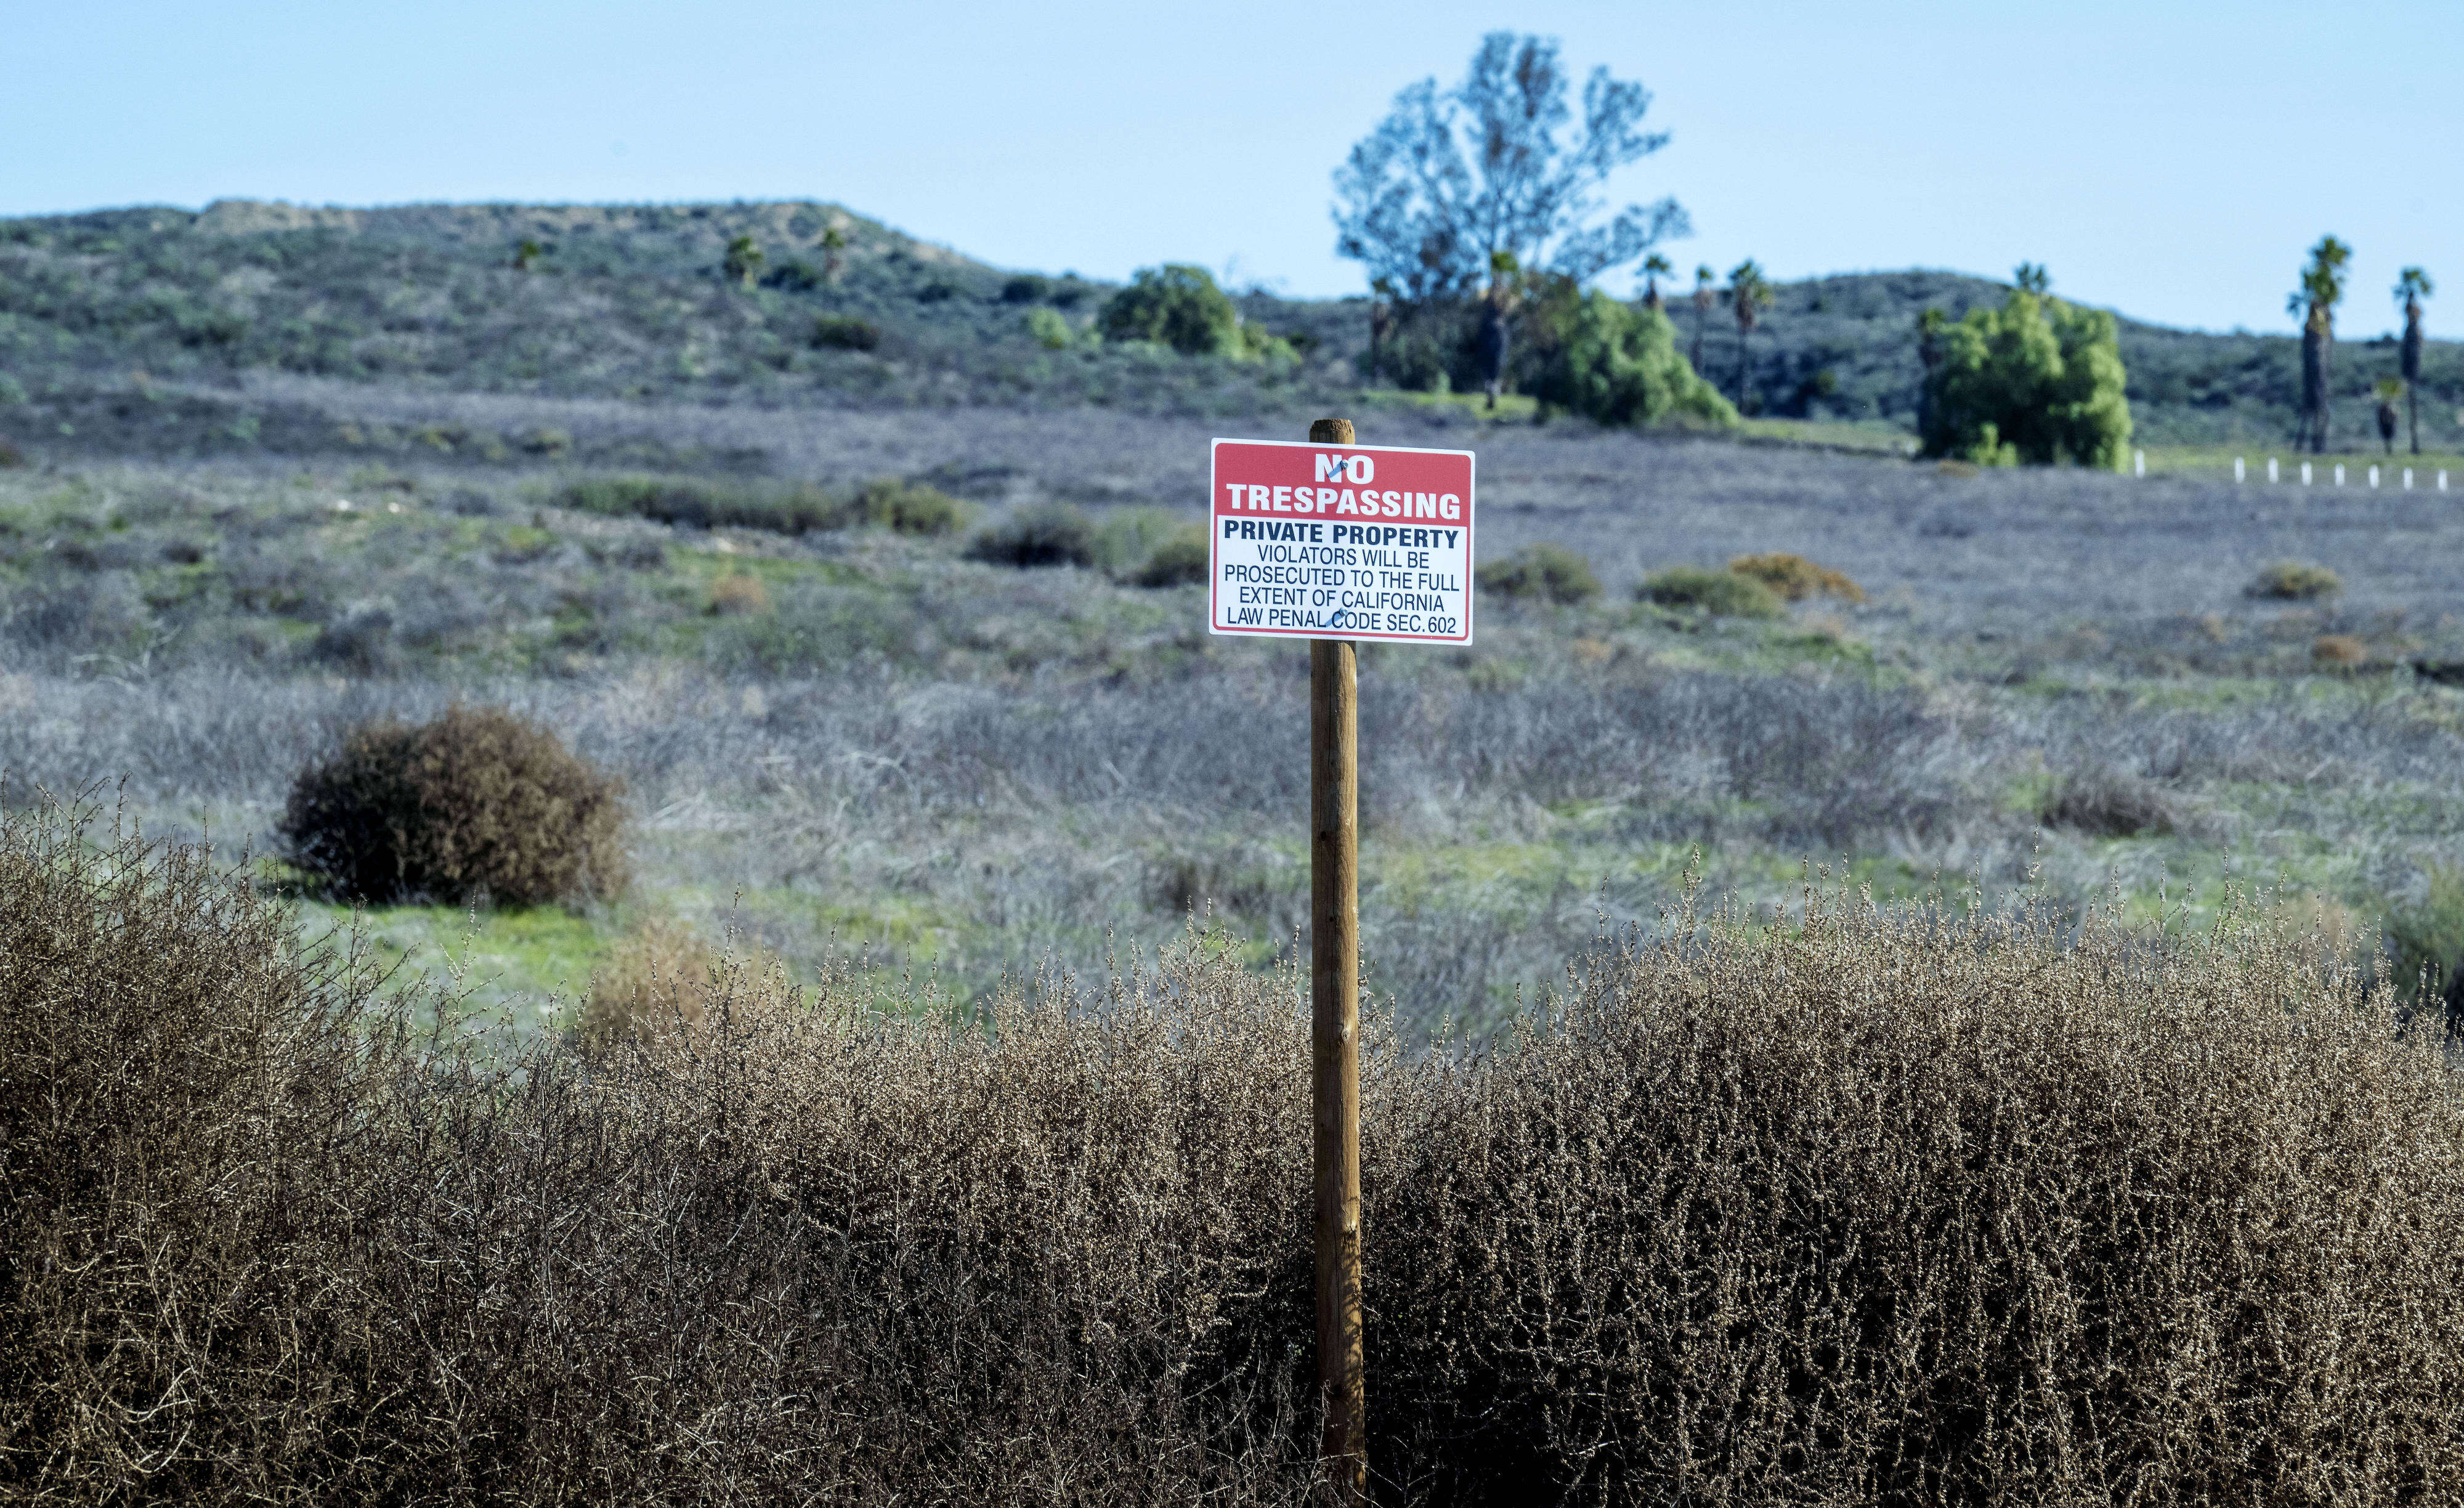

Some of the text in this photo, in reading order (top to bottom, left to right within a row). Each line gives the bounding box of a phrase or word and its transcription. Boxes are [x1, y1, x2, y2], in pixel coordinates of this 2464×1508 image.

[1315, 453, 1374, 484] NO
[1226, 484, 1460, 519] TRESPASSING
[1225, 520, 1459, 548] PRIVATE PROPERTY
[1258, 545, 1429, 569] VIOLATORS WILL BE
[1225, 565, 1459, 591] PROSECUTED TO THE FULL
[1240, 587, 1445, 612] EXTENT OF CALIFORNIA
[1228, 607, 1263, 625] LAW
[1269, 609, 1326, 627] PENAL
[1332, 612, 1380, 630] CODE
